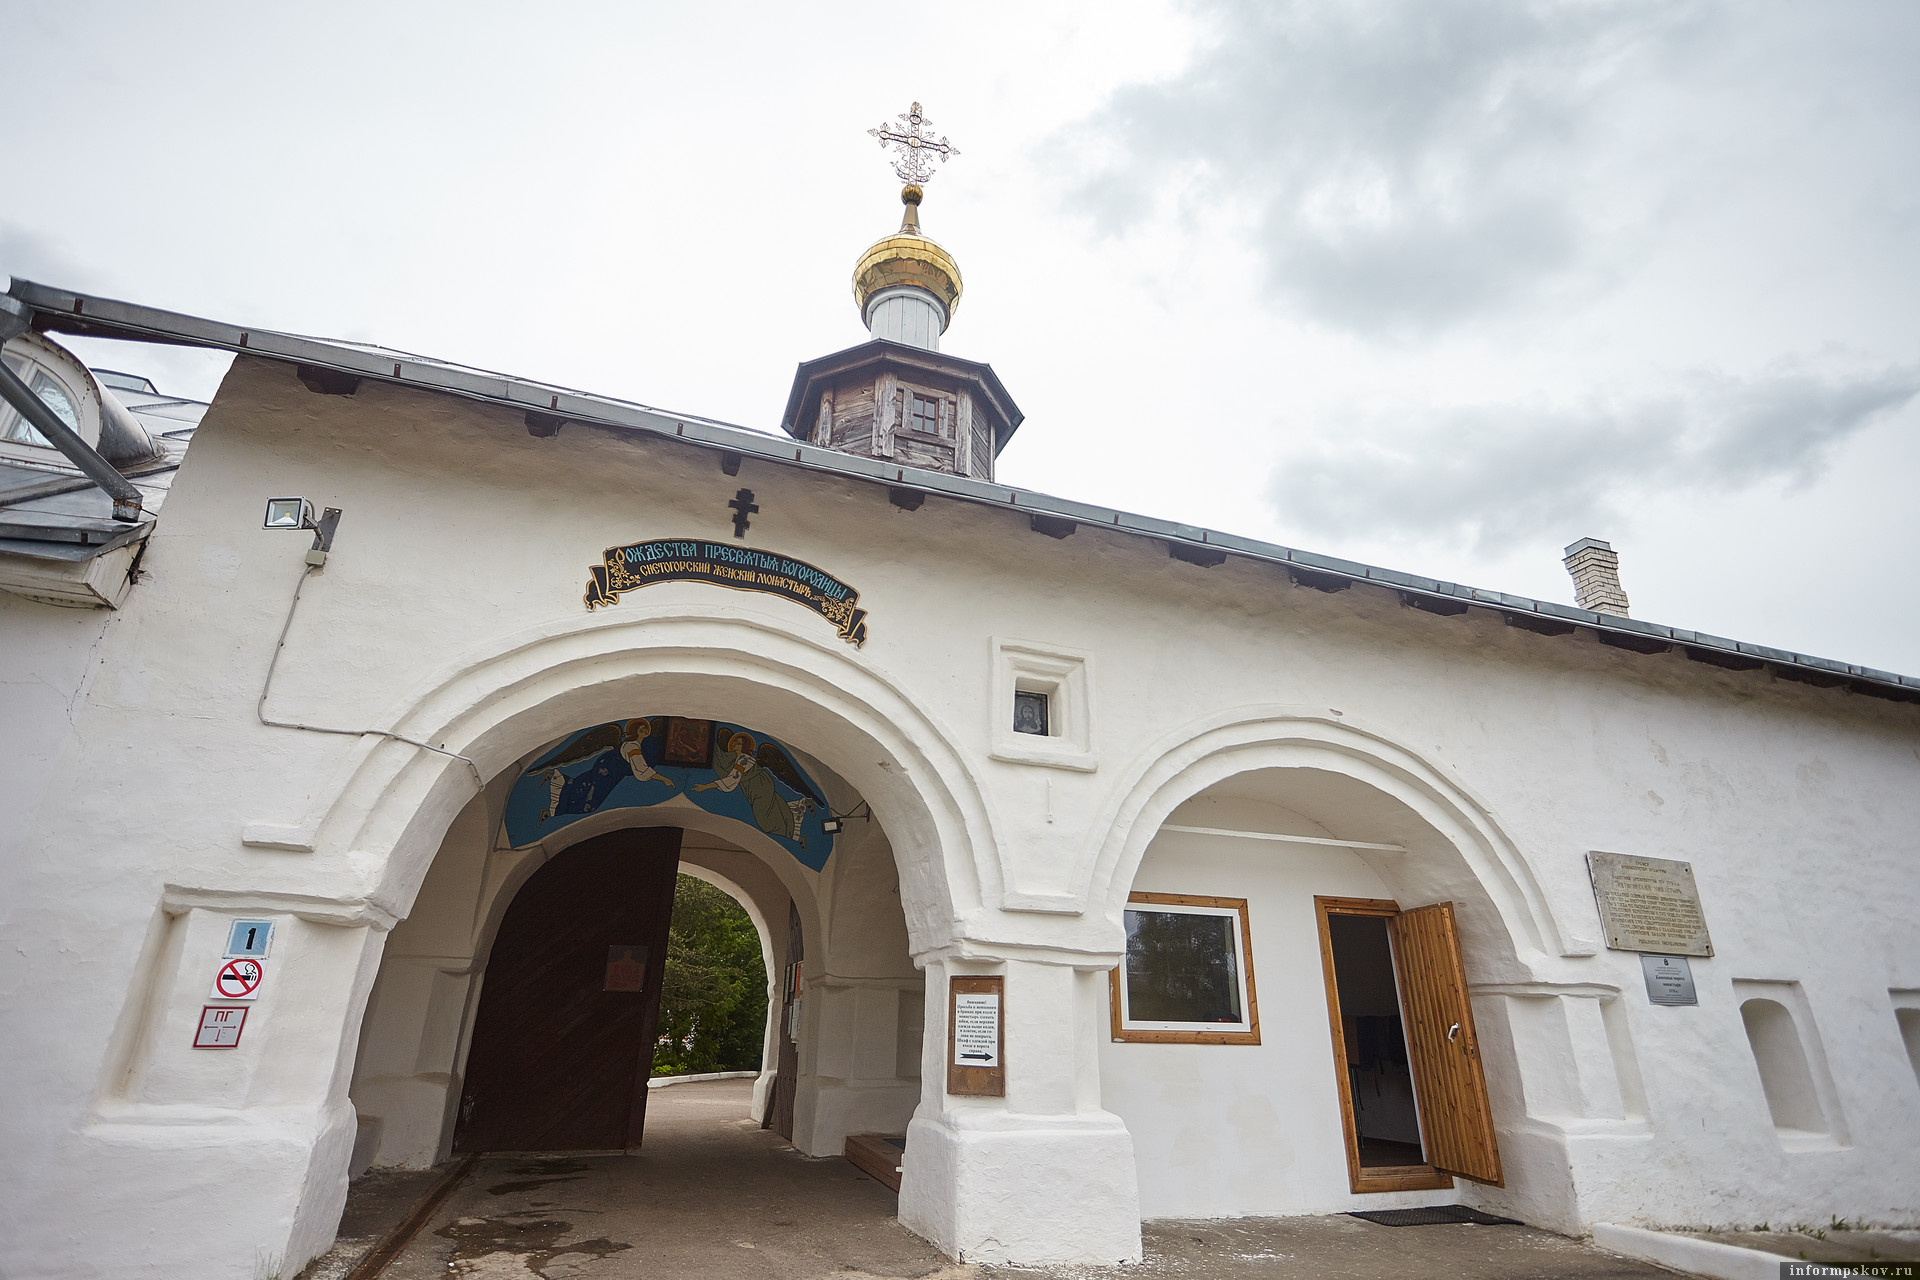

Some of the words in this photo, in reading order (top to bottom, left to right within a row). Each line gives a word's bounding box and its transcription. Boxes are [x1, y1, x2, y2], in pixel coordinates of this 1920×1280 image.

[640, 561, 710, 577] СНЕТОГОРСКИЙ
[712, 564, 756, 583] ЖЕНСКИЙ
[781, 559, 847, 600] БОГОРОДИЦЫ
[245, 927, 257, 950] 1
